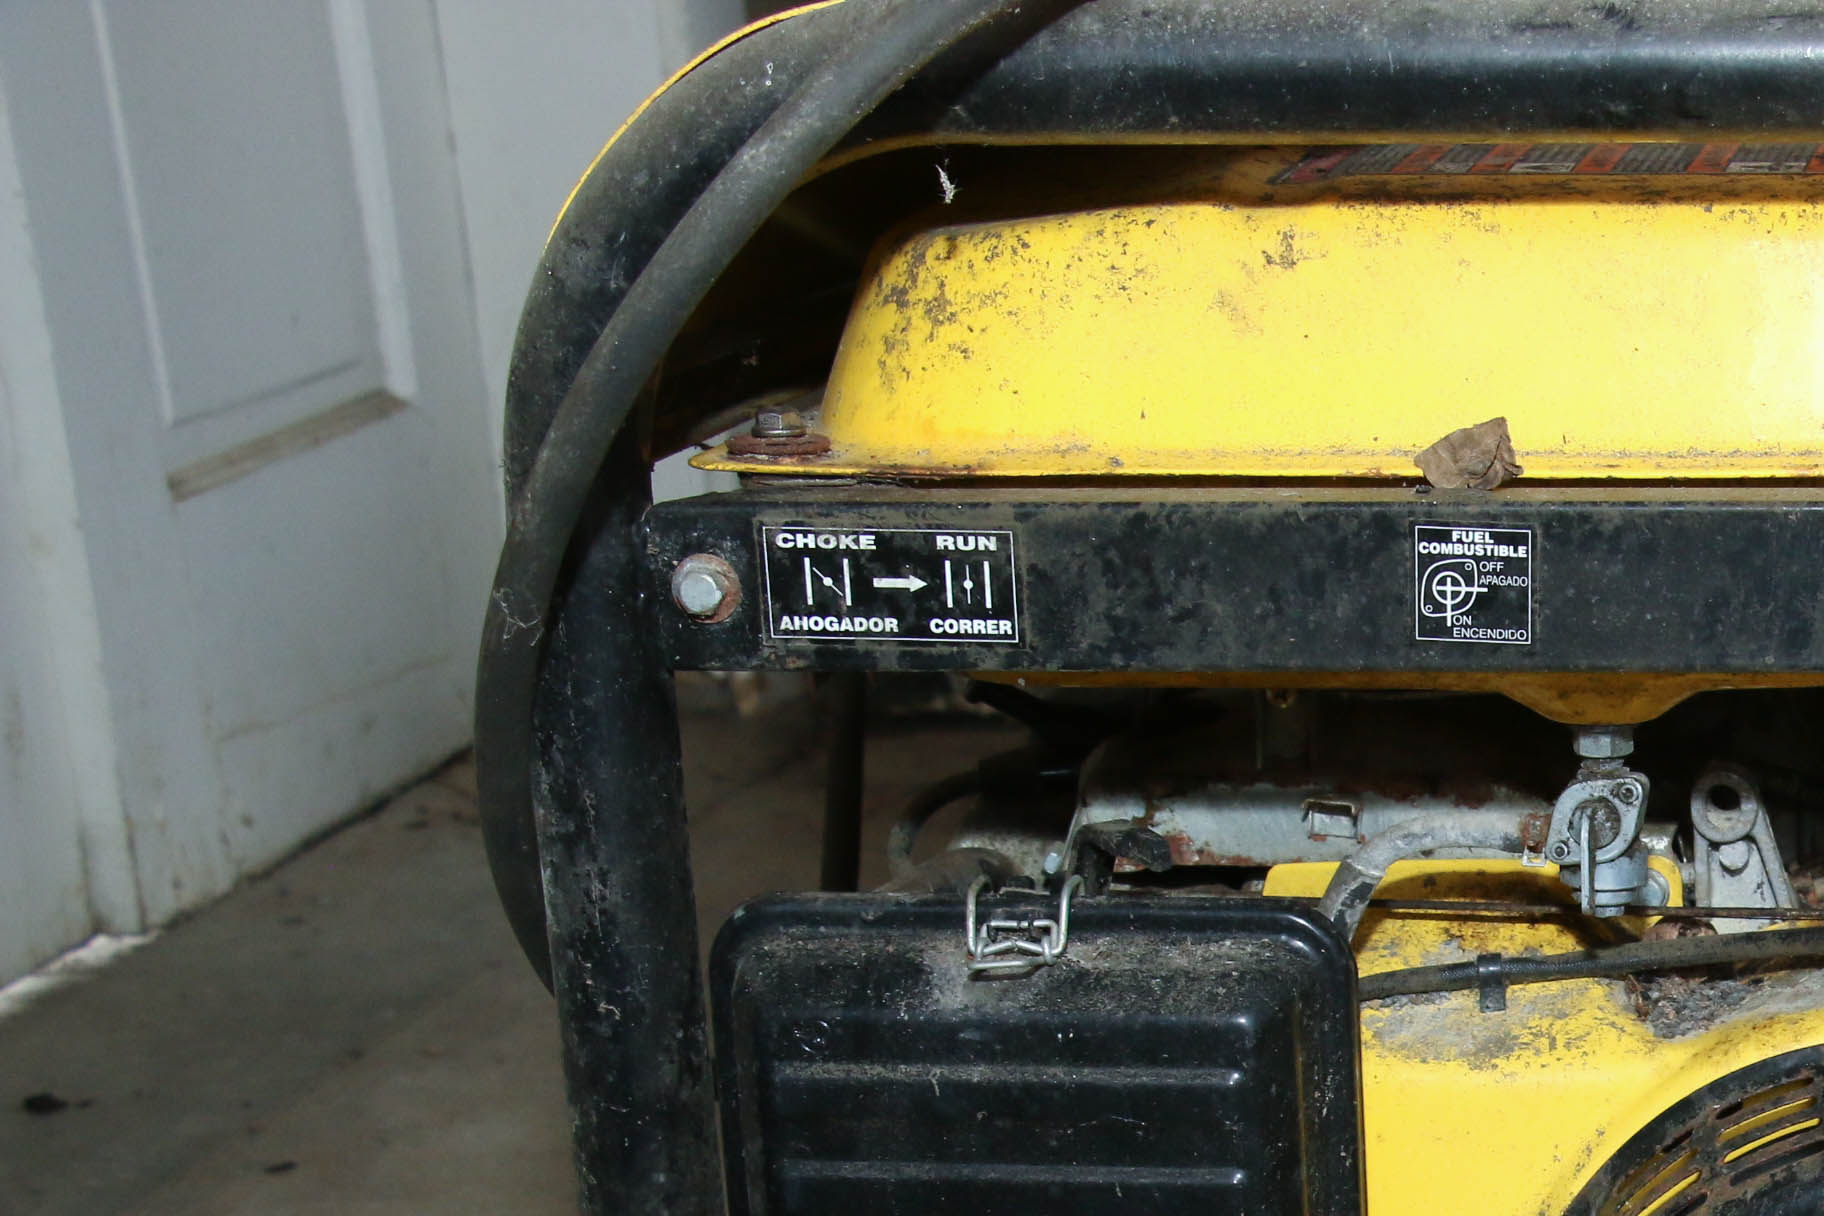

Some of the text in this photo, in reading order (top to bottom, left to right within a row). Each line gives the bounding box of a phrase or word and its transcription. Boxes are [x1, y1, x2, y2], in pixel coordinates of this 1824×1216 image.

[775, 532, 877, 550] CHOKE
[936, 535, 998, 552] RUN
[1452, 530, 1495, 544] FUEL
[1418, 541, 1528, 558] COMBUSTIBLE
[1479, 561, 1505, 573] OFF
[1479, 574, 1528, 587] APAGADO
[779, 615, 899, 633] AHOGADOR
[929, 618, 1013, 635] CORRER
[1453, 615, 1472, 626] ON
[1453, 627, 1527, 641] ENCENDIDO
